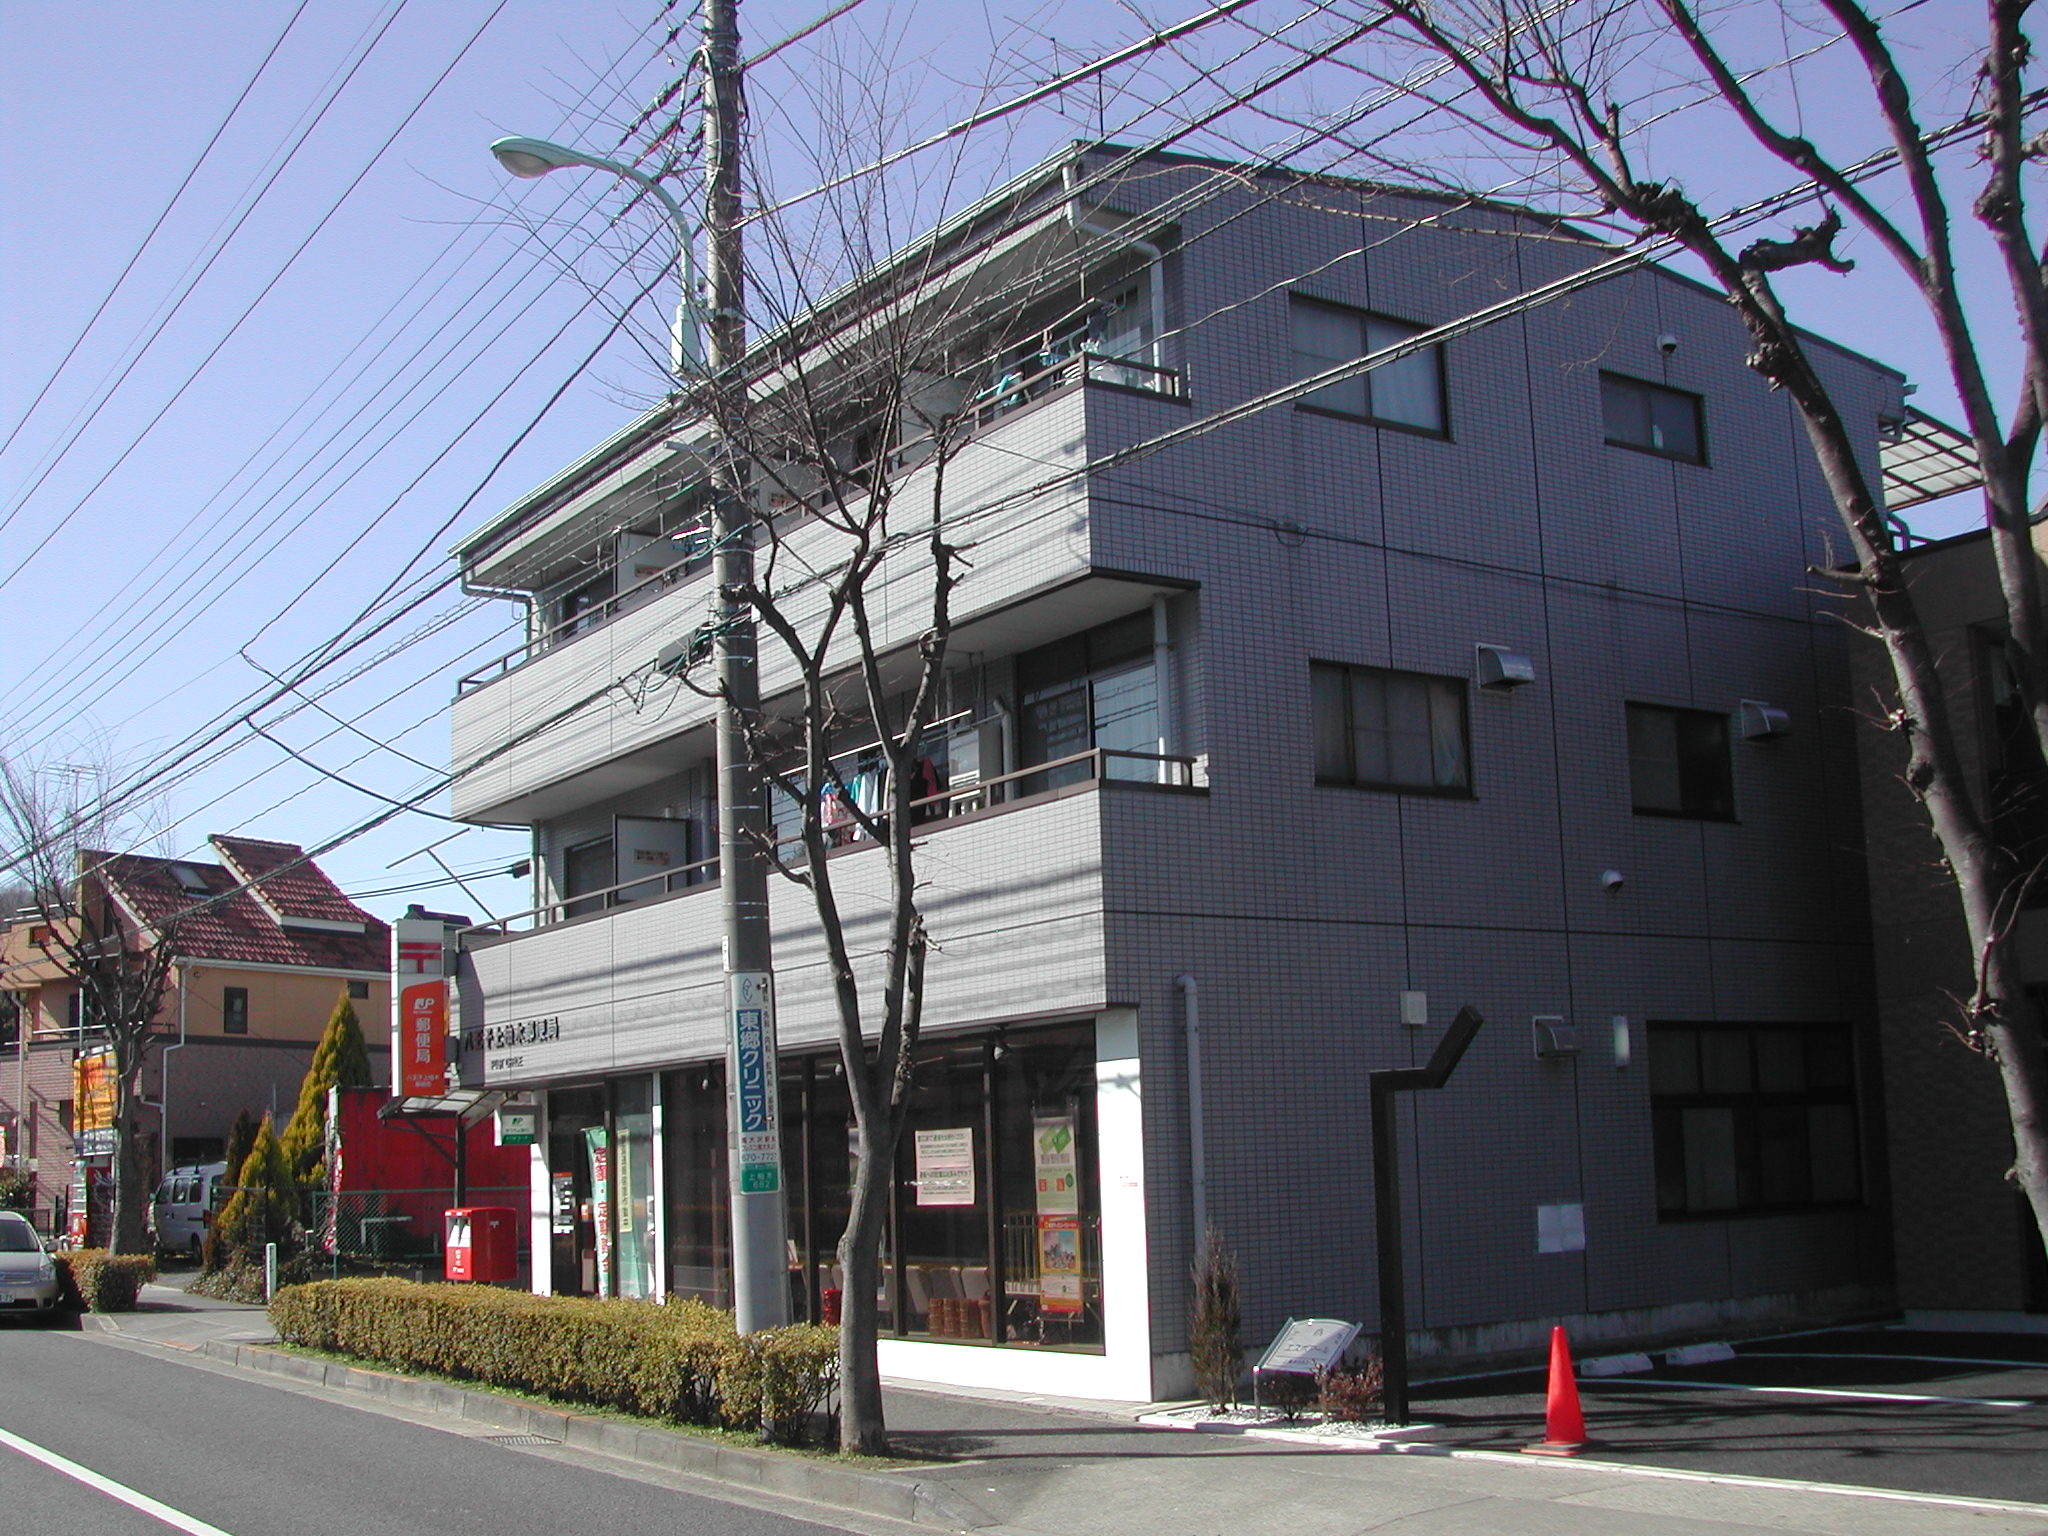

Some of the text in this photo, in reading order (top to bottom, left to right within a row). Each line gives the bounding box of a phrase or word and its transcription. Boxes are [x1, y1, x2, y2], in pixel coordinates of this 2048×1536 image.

[415, 1017, 431, 1064] 郵便局
[739, 1011, 762, 1130] 東郷クリニック
